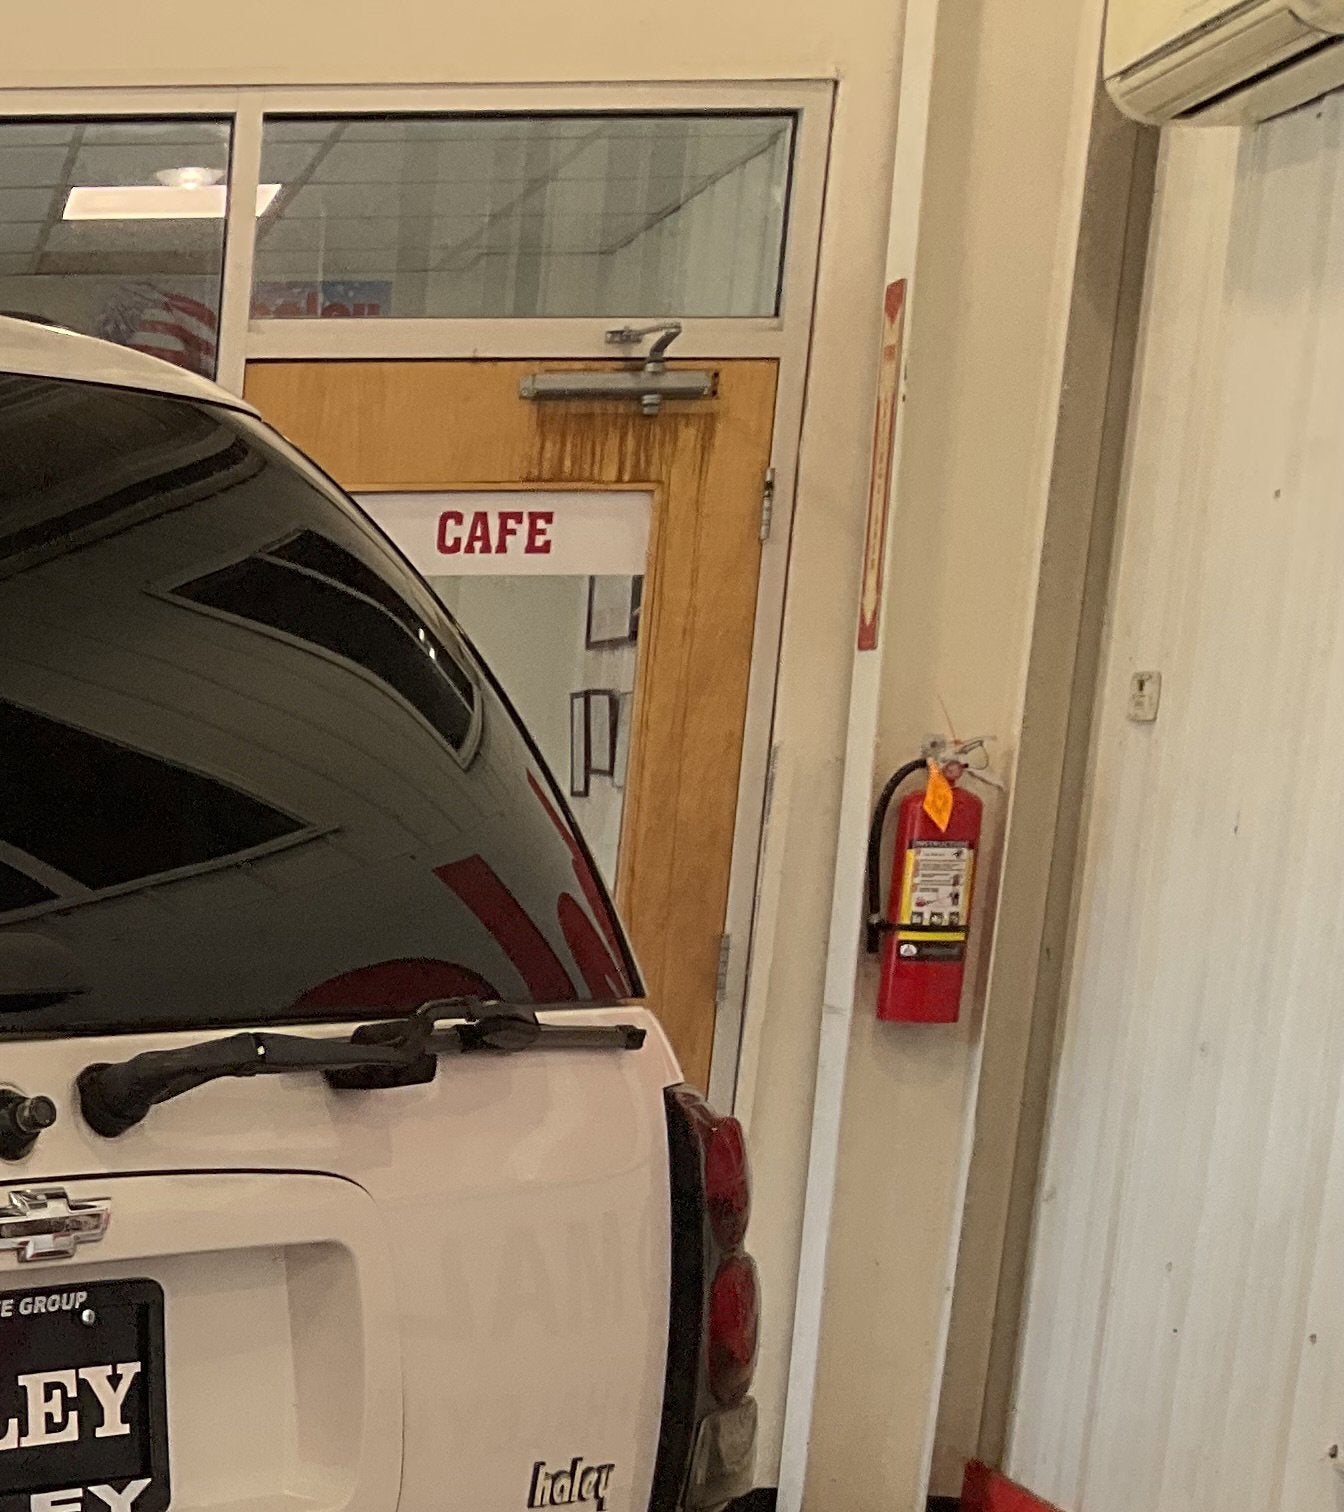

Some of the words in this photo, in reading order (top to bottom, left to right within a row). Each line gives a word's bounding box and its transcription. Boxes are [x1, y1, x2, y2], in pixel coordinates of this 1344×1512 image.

[436, 510, 554, 554] CAFE
[18, 1291, 88, 1315] GROUP
[527, 1456, 616, 1512] haley
